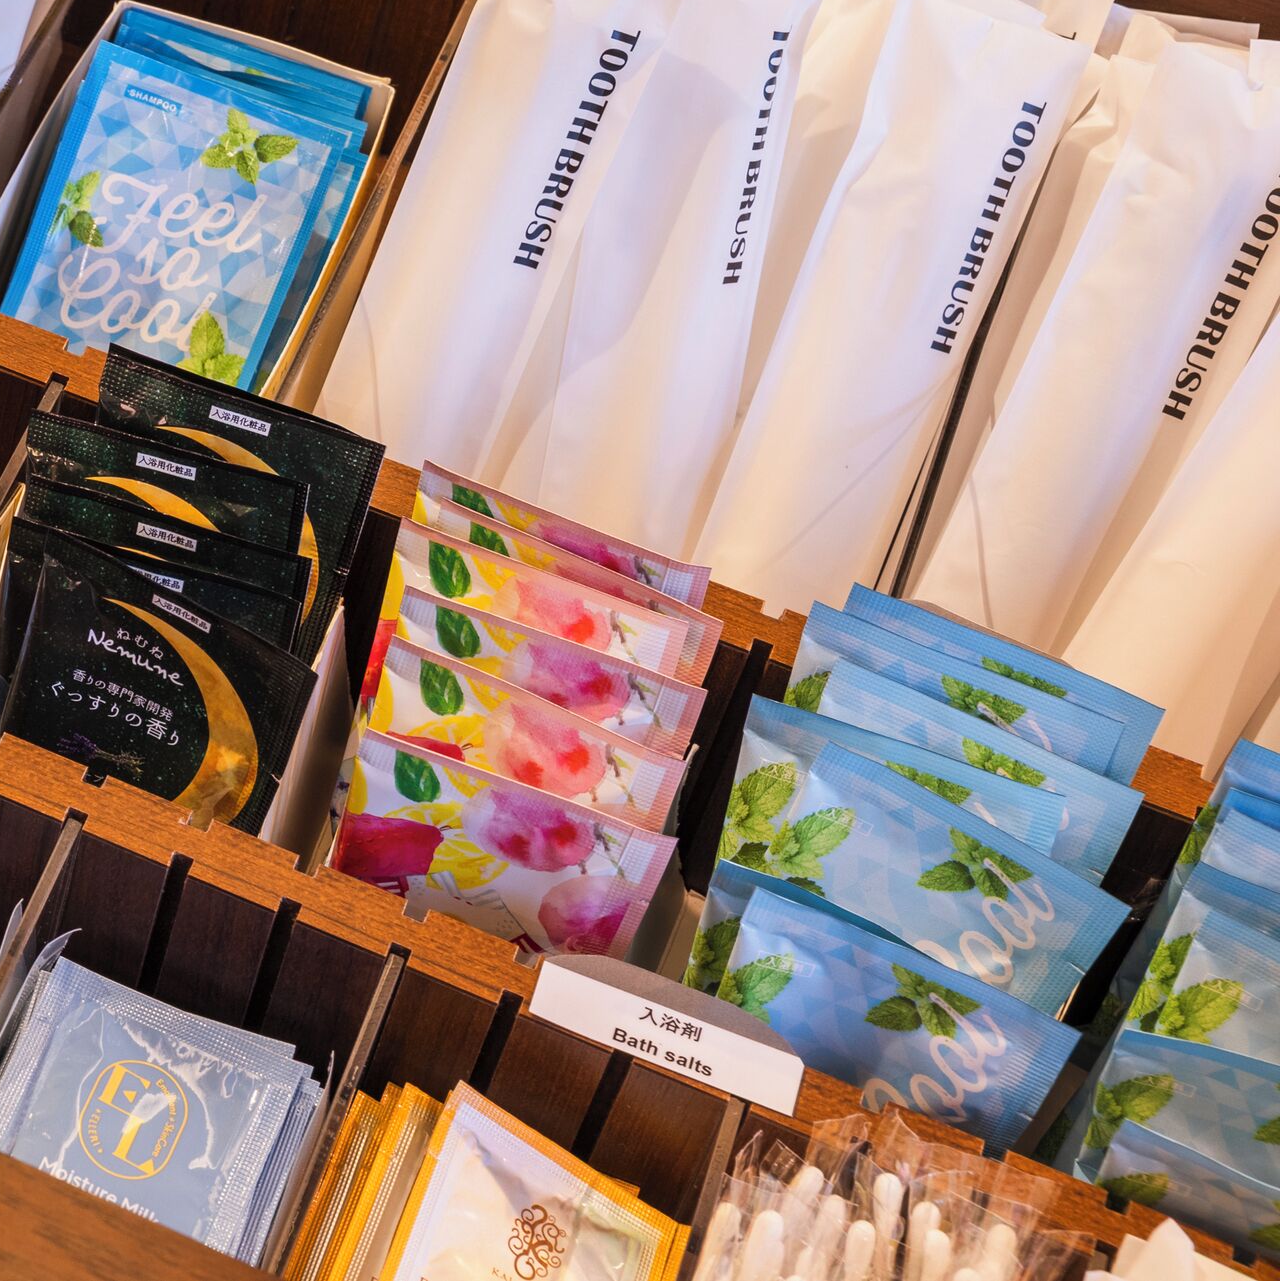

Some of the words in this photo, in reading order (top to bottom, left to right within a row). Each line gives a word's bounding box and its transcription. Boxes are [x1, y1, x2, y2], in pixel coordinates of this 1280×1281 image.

[127, 88, 177, 112] SHAMPOO
[566, 30, 641, 145] TOOTH
[751, 25, 792, 151] TOOTH
[981, 101, 1047, 222] TOOTH
[88, 173, 268, 254] Feel
[512, 148, 586, 269] BRUSH
[722, 159, 762, 285] BRUSH
[1224, 172, 1280, 291] OOTH
[127, 237, 209, 291] so
[930, 227, 995, 354] BRUSH
[58, 254, 218, 352] Cool
[1162, 291, 1241, 420] BRUSH
[211, 408, 268, 433] 入浴用化粧品
[138, 455, 193, 478] 入浴用化粧品
[138, 525, 194, 549] 入浴用化粧品
[136, 569, 181, 590] 用化粧品
[154, 596, 208, 630] 入浴用化粧品
[87, 628, 185, 687] Nemune
[116, 627, 164, 660] ねむね
[51, 681, 180, 746] ぐっすりの香り
[72, 668, 174, 722] 香りの専門家開発
[639, 1006, 703, 1042] 入浴剤
[612, 1027, 659, 1056] Bath
[664, 1050, 713, 1076] salts
[863, 992, 1007, 1122] ool
[87, 1113, 101, 1147] ELLERI
[152, 1122, 175, 1157] SkinCare
[38, 1156, 118, 1205] Moisture
